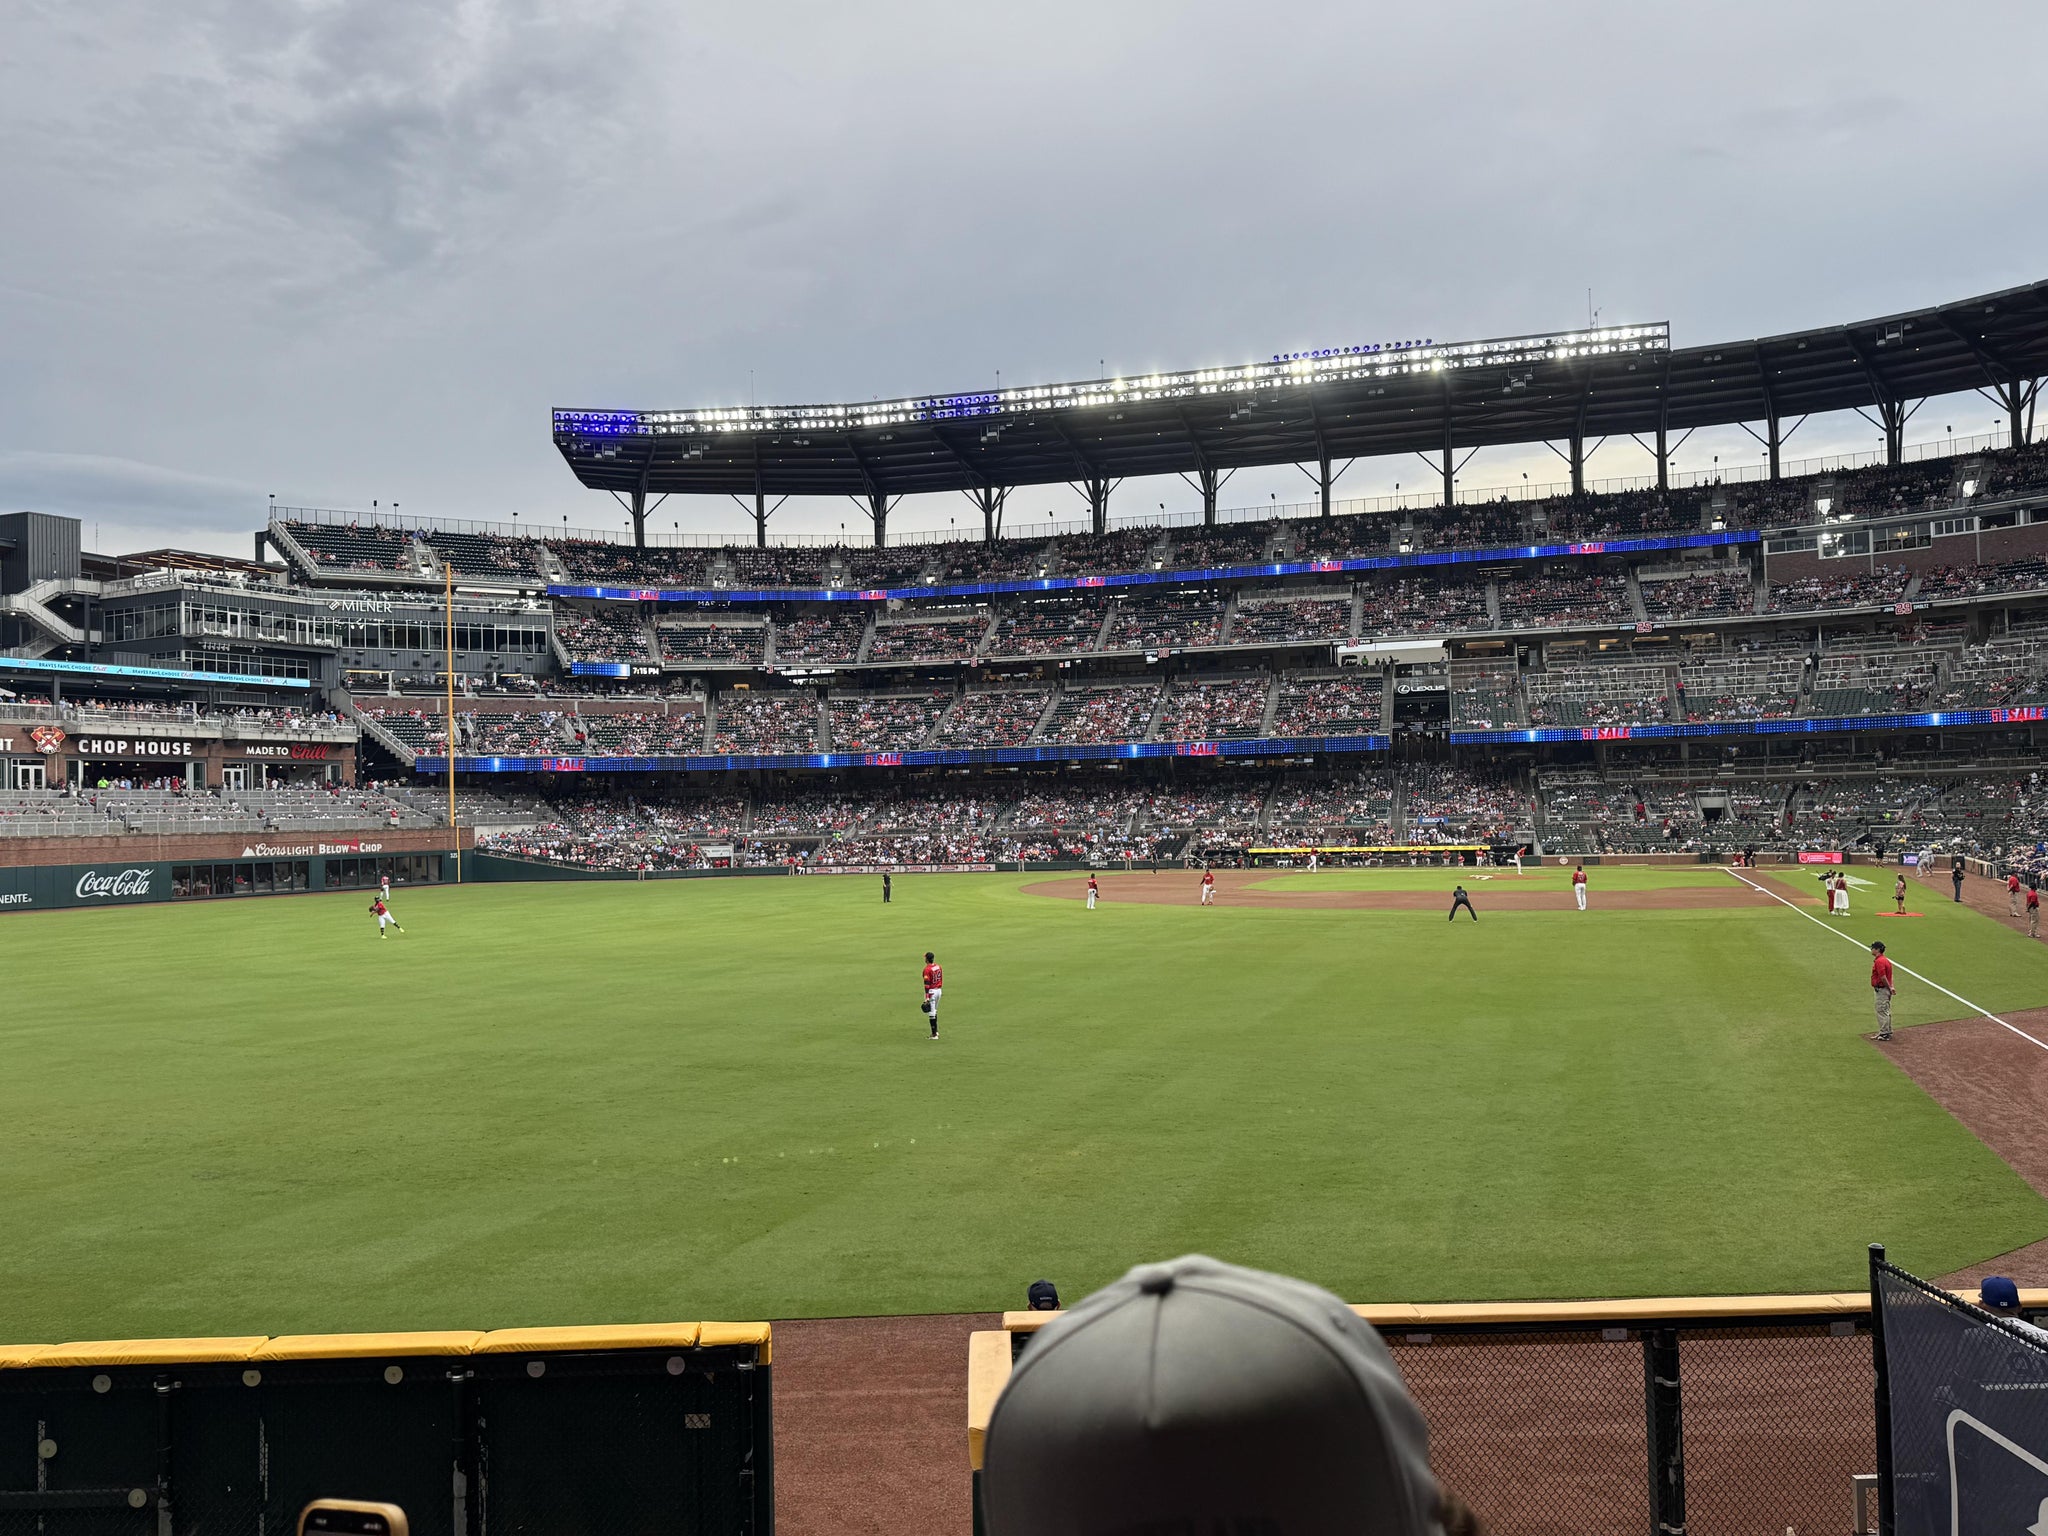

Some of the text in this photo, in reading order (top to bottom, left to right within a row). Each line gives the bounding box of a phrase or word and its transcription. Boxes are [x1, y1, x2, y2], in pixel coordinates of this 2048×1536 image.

[1581, 543, 1604, 554] SALE
[1320, 561, 1343, 571] SALE
[1086, 577, 1105, 587] SALE
[639, 590, 659, 600] SALE
[868, 590, 887, 600] SALE
[341, 601, 393, 613] MILNER
[1895, 602, 1913, 615] 29
[1636, 621, 1652, 633] 25
[1158, 647, 1170, 658] 10
[632, 667, 659, 675] 7:15 PM
[766, 664, 774, 674] 3
[1991, 707, 2045, 722] 51 SALE
[1582, 727, 1630, 740] 51 SALE
[78, 739, 128, 754] CHOP
[135, 740, 193, 755] HOUSE
[246, 743, 330, 760] MADE TO Chill
[1189, 742, 1219, 756] SALE
[555, 758, 586, 771] SALE
[876, 753, 903, 766] SALE
[255, 842, 287, 857] Coors
[287, 845, 314, 856] LIGHT
[319, 844, 350, 854] BELOW
[359, 843, 383, 853] CHOP
[75, 868, 155, 898] Coca-Cola
